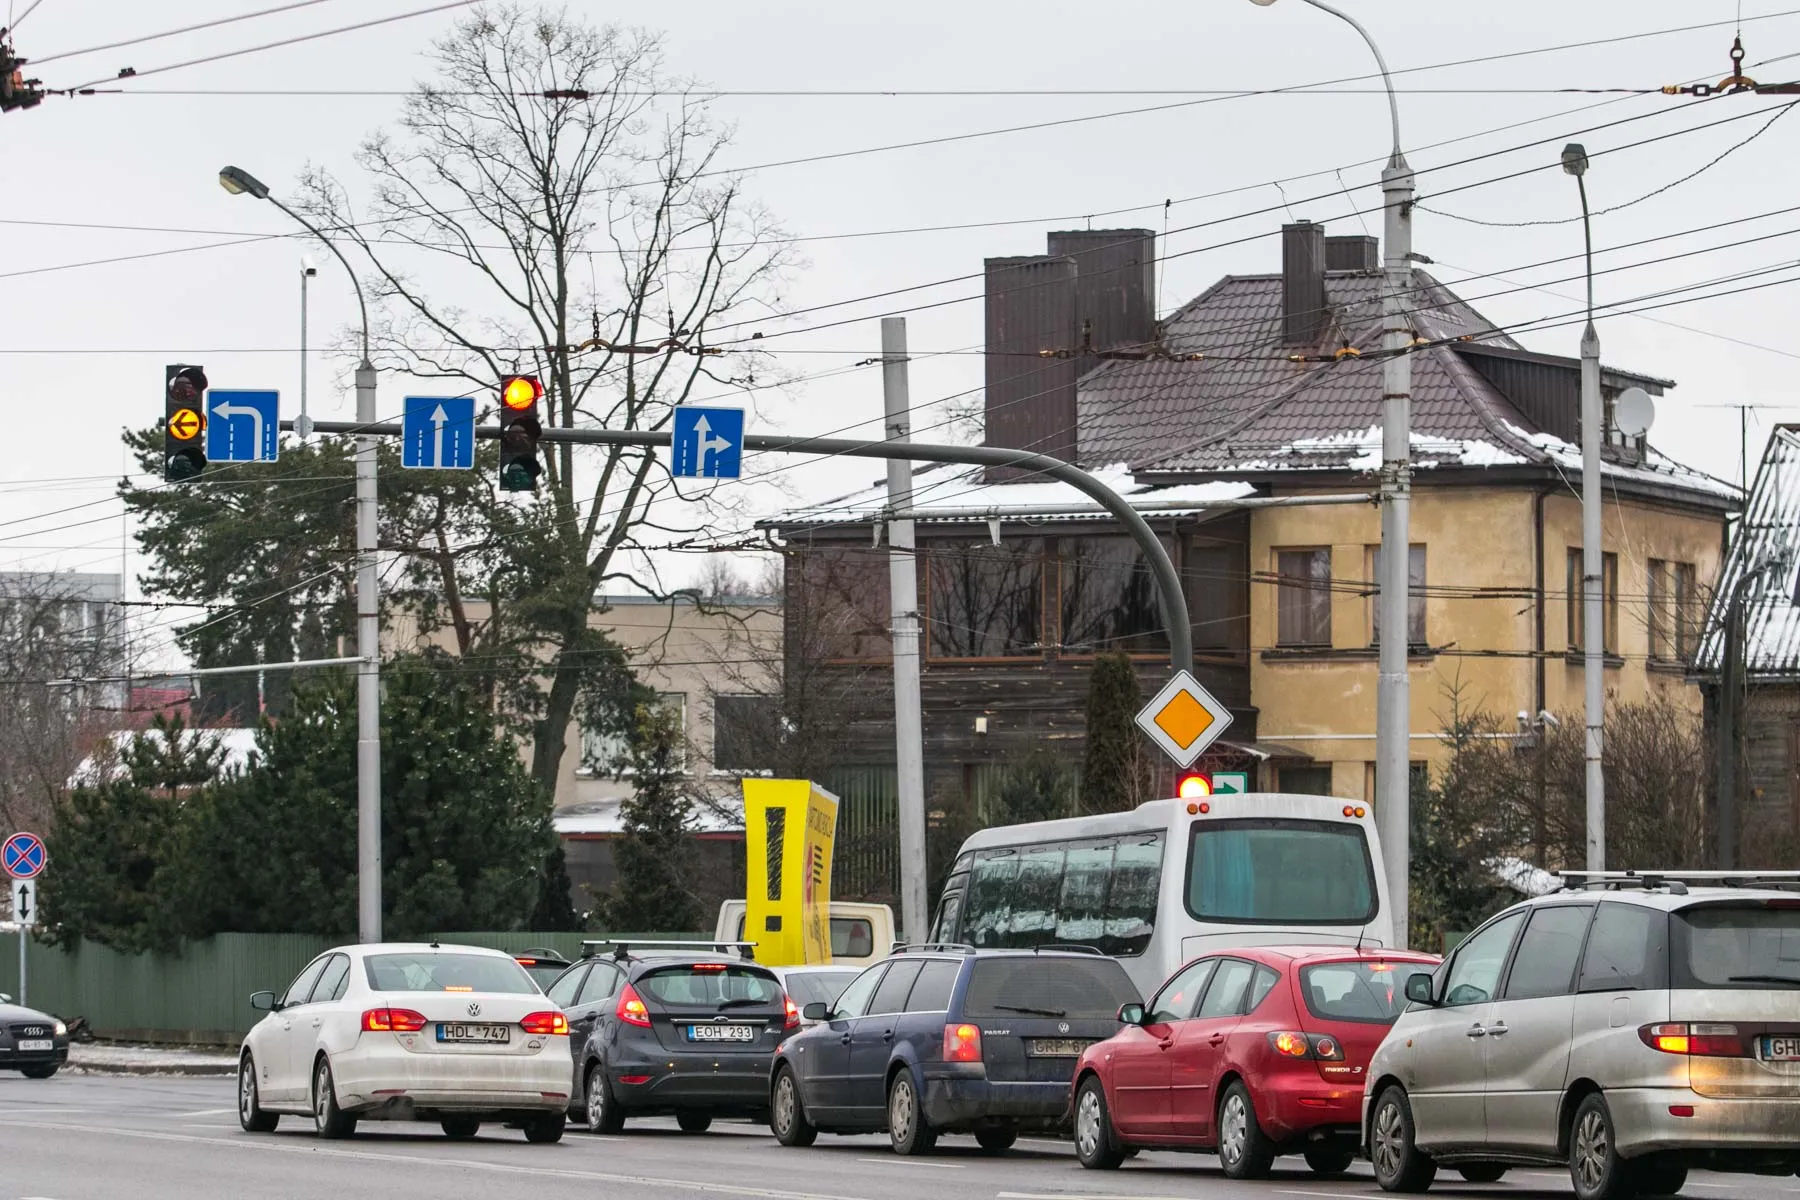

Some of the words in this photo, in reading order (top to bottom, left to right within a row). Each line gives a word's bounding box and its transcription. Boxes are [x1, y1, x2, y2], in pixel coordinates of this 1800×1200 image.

[445, 1026, 474, 1038] HDL
[482, 1027, 506, 1040] 747
[695, 1026, 722, 1038] EOH
[729, 1027, 752, 1038] 293
[1035, 1040, 1063, 1053] GRP
